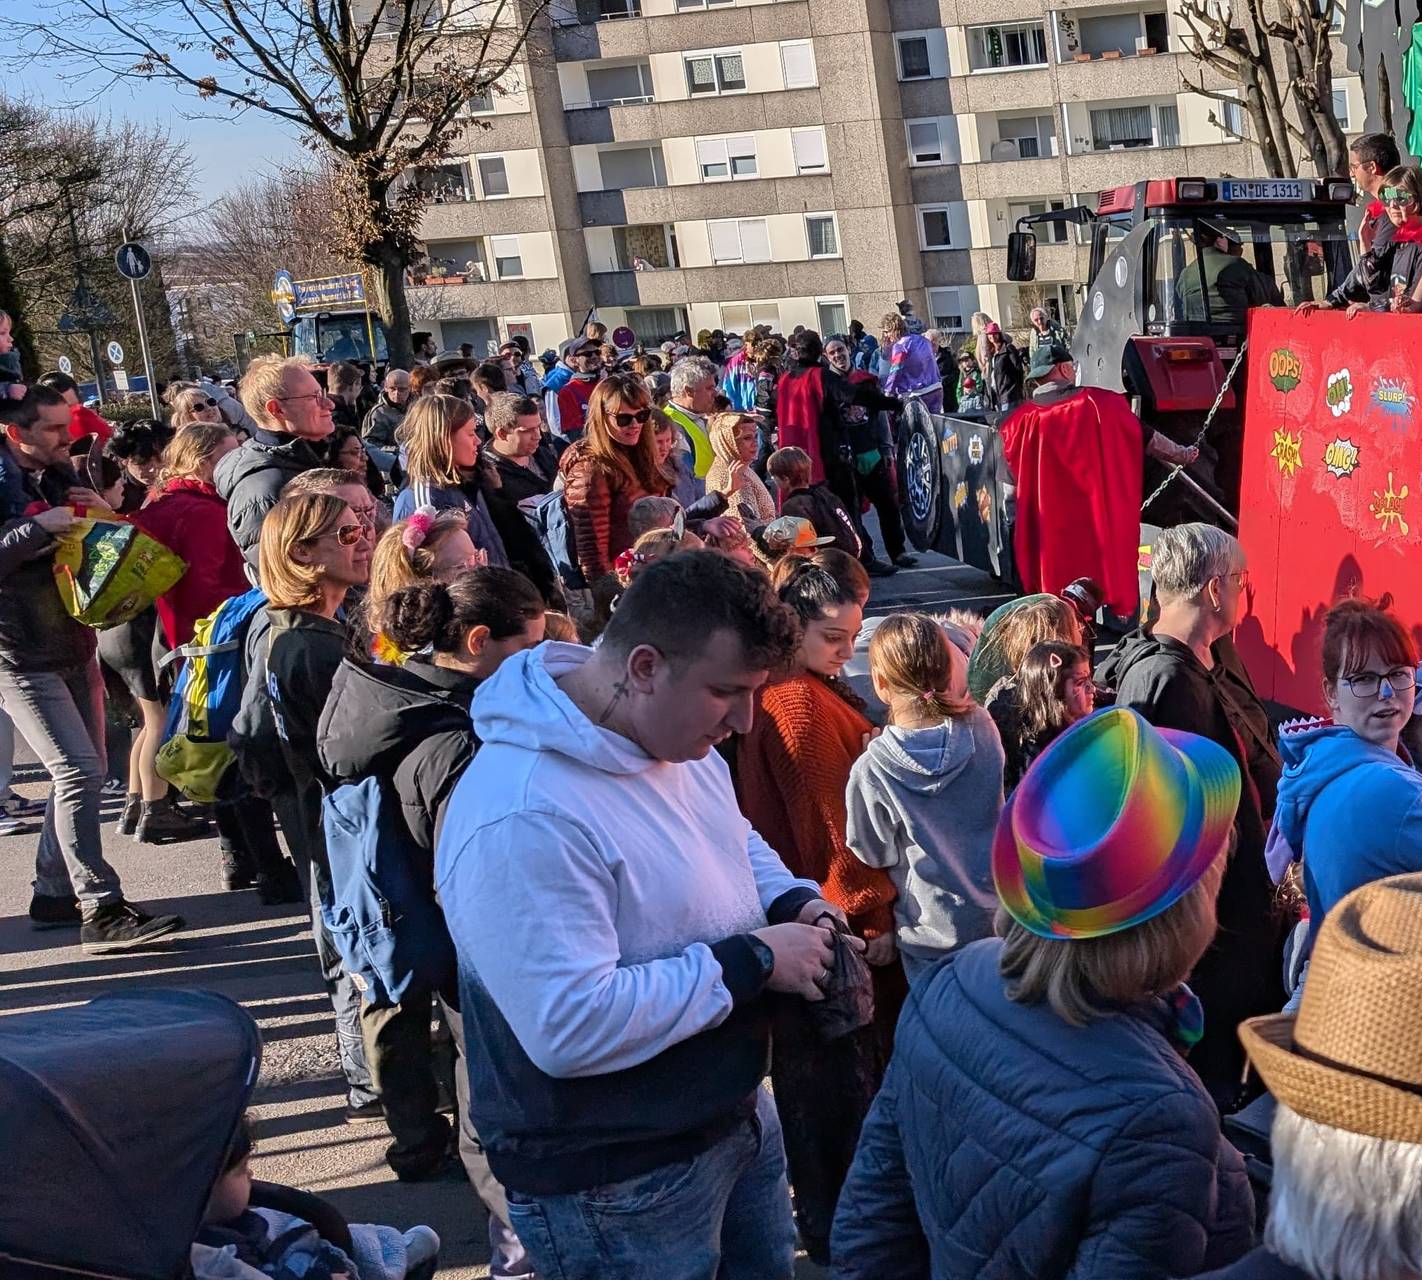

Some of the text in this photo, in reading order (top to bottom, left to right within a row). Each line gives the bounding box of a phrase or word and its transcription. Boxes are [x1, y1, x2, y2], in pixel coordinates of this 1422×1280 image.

[1232, 183, 1300, 198] EN DE 1311
[1269, 351, 1303, 379] OOPS!
[1325, 442, 1357, 472] OMG!
